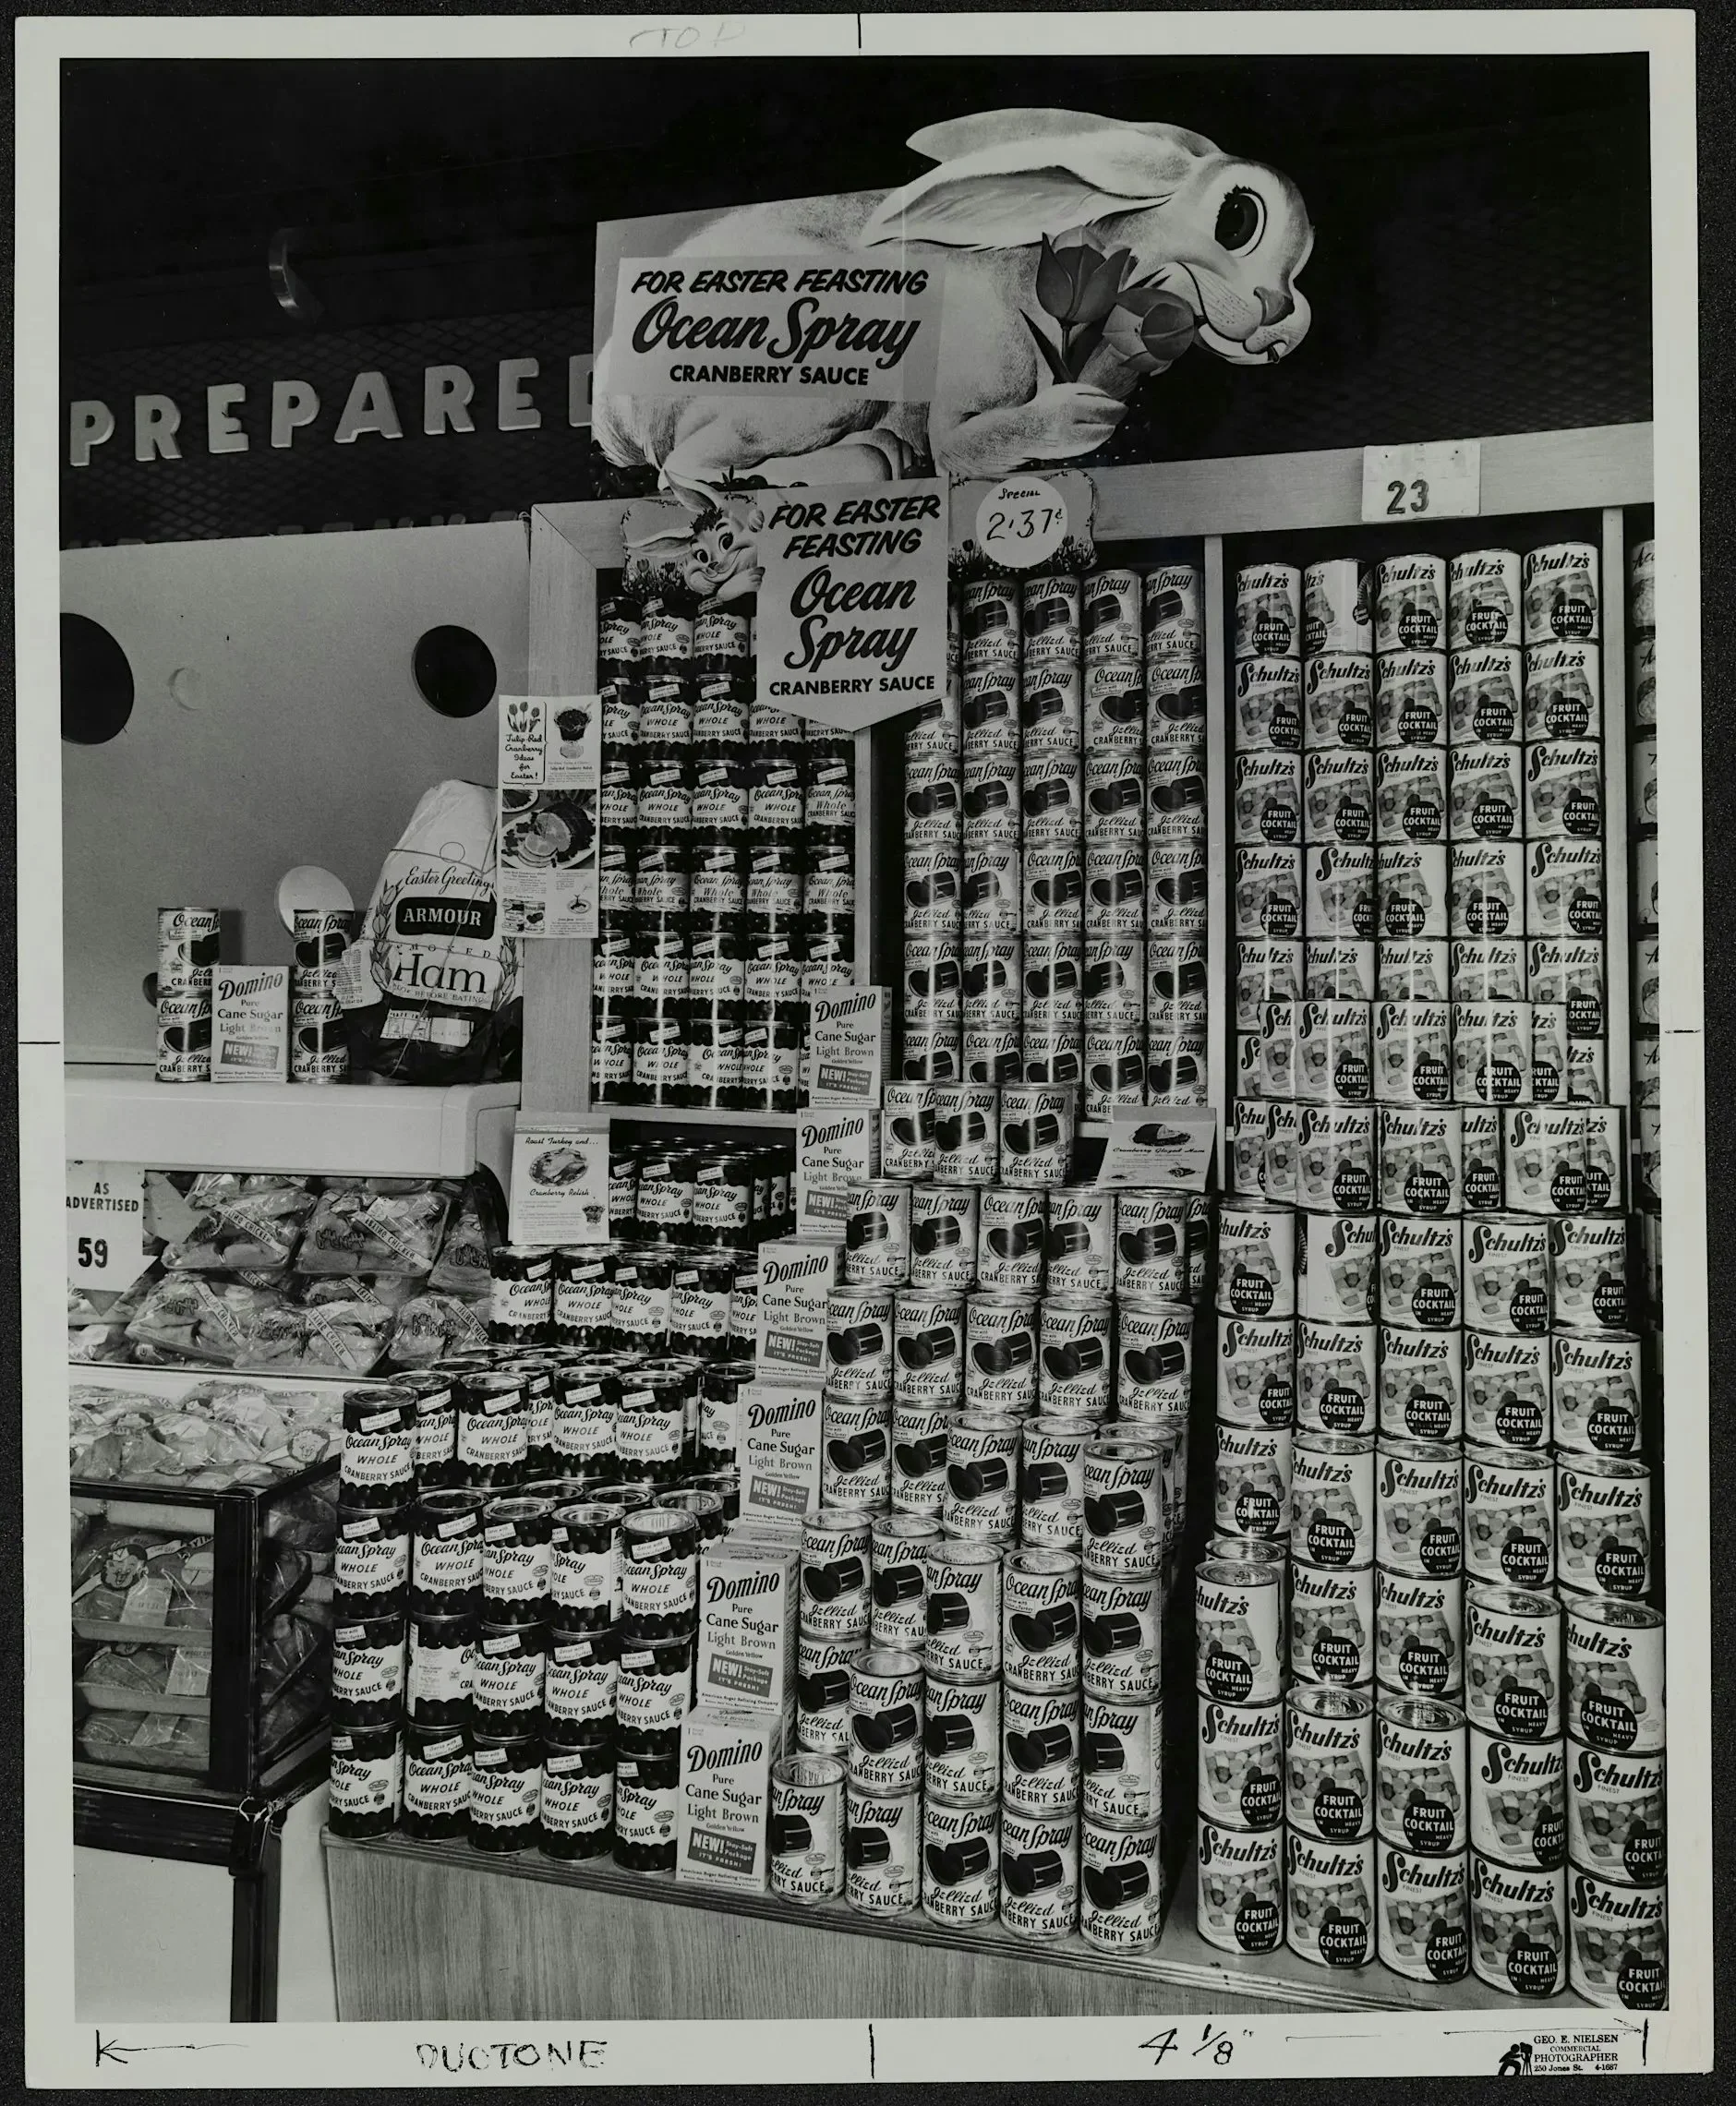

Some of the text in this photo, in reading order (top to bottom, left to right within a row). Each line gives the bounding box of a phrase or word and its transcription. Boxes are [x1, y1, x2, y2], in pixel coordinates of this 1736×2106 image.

[631, 269, 929, 295] FOR EASTER FEASTING
[632, 295, 922, 369] Ocean Spray
[669, 365, 869, 386] CRANBERRY SAUCE
[1386, 479, 1429, 514] 23
[768, 494, 941, 530] FOR EASTER
[782, 527, 922, 560] FEASTING
[1524, 551, 1590, 589] Schultz's
[790, 564, 917, 618] Ocean
[1558, 605, 1585, 615] FRUIT
[1551, 614, 1593, 625] COCKTAIL
[783, 615, 919, 673] Spray
[769, 675, 934, 696] CRANBERRY SAUCE
[1237, 664, 1300, 698] Schultz's
[505, 744, 543, 755] Cranberry
[519, 764, 530, 772] for
[1306, 755, 1368, 789] Schultz's
[1528, 746, 1598, 782] Schultz's
[639, 788, 692, 804] Ocean Spray
[647, 803, 679, 812] WHOLE
[1342, 809, 1367, 819] FRUIT
[1572, 800, 1596, 812] FRUIT
[1335, 819, 1370, 829] COCKTAIL
[1087, 852, 1120, 869] Ocean
[404, 865, 440, 886] Easter
[439, 866, 495, 897] Greetings
[404, 908, 482, 926] ARMOUR
[392, 954, 487, 993] Ham
[218, 972, 283, 1001] Domino
[218, 1008, 283, 1023] Cane Sugar
[814, 993, 876, 1023] Domino
[220, 1023, 246, 1035] Light
[814, 1031, 876, 1045] Cane Sugar
[816, 1046, 874, 1059] Light Brown
[820, 1066, 847, 1082] NEW!
[801, 1117, 863, 1148] Domino
[1298, 1108, 1370, 1146] Schultz's
[548, 1137, 573, 1146] Turkey
[93, 1182, 110, 1195] AS
[529, 1189, 565, 1197] Cranberry
[66, 1197, 139, 1212] ADVERTISED
[1380, 1218, 1453, 1257] Schultz's
[1468, 1224, 1546, 1264] Schultz's
[78, 1237, 108, 1268] 59
[763, 1254, 829, 1285] Domino
[1421, 1288, 1450, 1299] FRUIT
[1519, 1294, 1543, 1305] FRUIT
[762, 1294, 828, 1311] Cane Sugar
[1413, 1299, 1456, 1310] COCKTAIL
[969, 1306, 1007, 1329] Ocean
[1121, 1316, 1192, 1342] Ocean Spray
[767, 1334, 796, 1350] NEW!
[1551, 1338, 1633, 1377] Schultz's
[1131, 1387, 1178, 1399] Jellied
[555, 1407, 614, 1422] Ocean Spray
[747, 1398, 816, 1429] Domino
[1597, 1413, 1628, 1424] FRUIT
[467, 1417, 503, 1431] Ocean
[562, 1426, 598, 1436] WHOLE
[1589, 1424, 1634, 1437] COCKTAIL
[346, 1435, 412, 1450] Ocean Spray
[481, 1434, 518, 1444] WHOLE
[357, 1454, 398, 1464] WHOLE
[466, 1447, 511, 1460] CRANBERRY
[344, 1462, 410, 1481] CRANBERRY SAUCE
[1557, 1473, 1643, 1511] Schultz's
[1605, 1553, 1638, 1565] FRUIT
[1597, 1563, 1646, 1577] COCKTAIL
[706, 1570, 779, 1603] Domino
[1006, 1571, 1052, 1599] Ocean
[732, 1604, 753, 1614] Pure
[705, 1614, 778, 1635] Cane Sugar
[707, 1631, 776, 1650] Light Brown
[498, 1661, 536, 1677] Spray
[712, 1657, 742, 1678] NEW!
[1019, 1654, 1071, 1668] Jellied
[480, 1679, 517, 1691] WHOLE
[510, 1690, 535, 1706] SAUCE
[687, 1739, 763, 1773] Domino
[420, 1781, 461, 1794] WHOLE
[712, 1774, 734, 1785] Pure
[952, 1776, 988, 1791] SAUCE
[685, 1784, 763, 1808] Cane Sugar
[687, 1803, 759, 1823] Light Brown
[959, 1810, 997, 1837] Spray
[693, 1832, 725, 1854] NEW!
[1200, 1825, 1277, 1866] Schultz's
[1381, 1850, 1465, 1893] Schultz's
[1471, 1858, 1555, 1903] Schultz's
[1572, 1875, 1662, 1919] Schultz's
[1091, 1909, 1141, 1928] Jellied
[1245, 1907, 1272, 1919] FRUIT
[1236, 1919, 1278, 1932] COCKTAIL
[1435, 1934, 1464, 1948] FRUIT
[1516, 1951, 1549, 1964] FRUIT
[1508, 1960, 1558, 1975] COCKTAIL
[1629, 1968, 1660, 1981] FRUIT
[1139, 2028, 1178, 2065] 4
